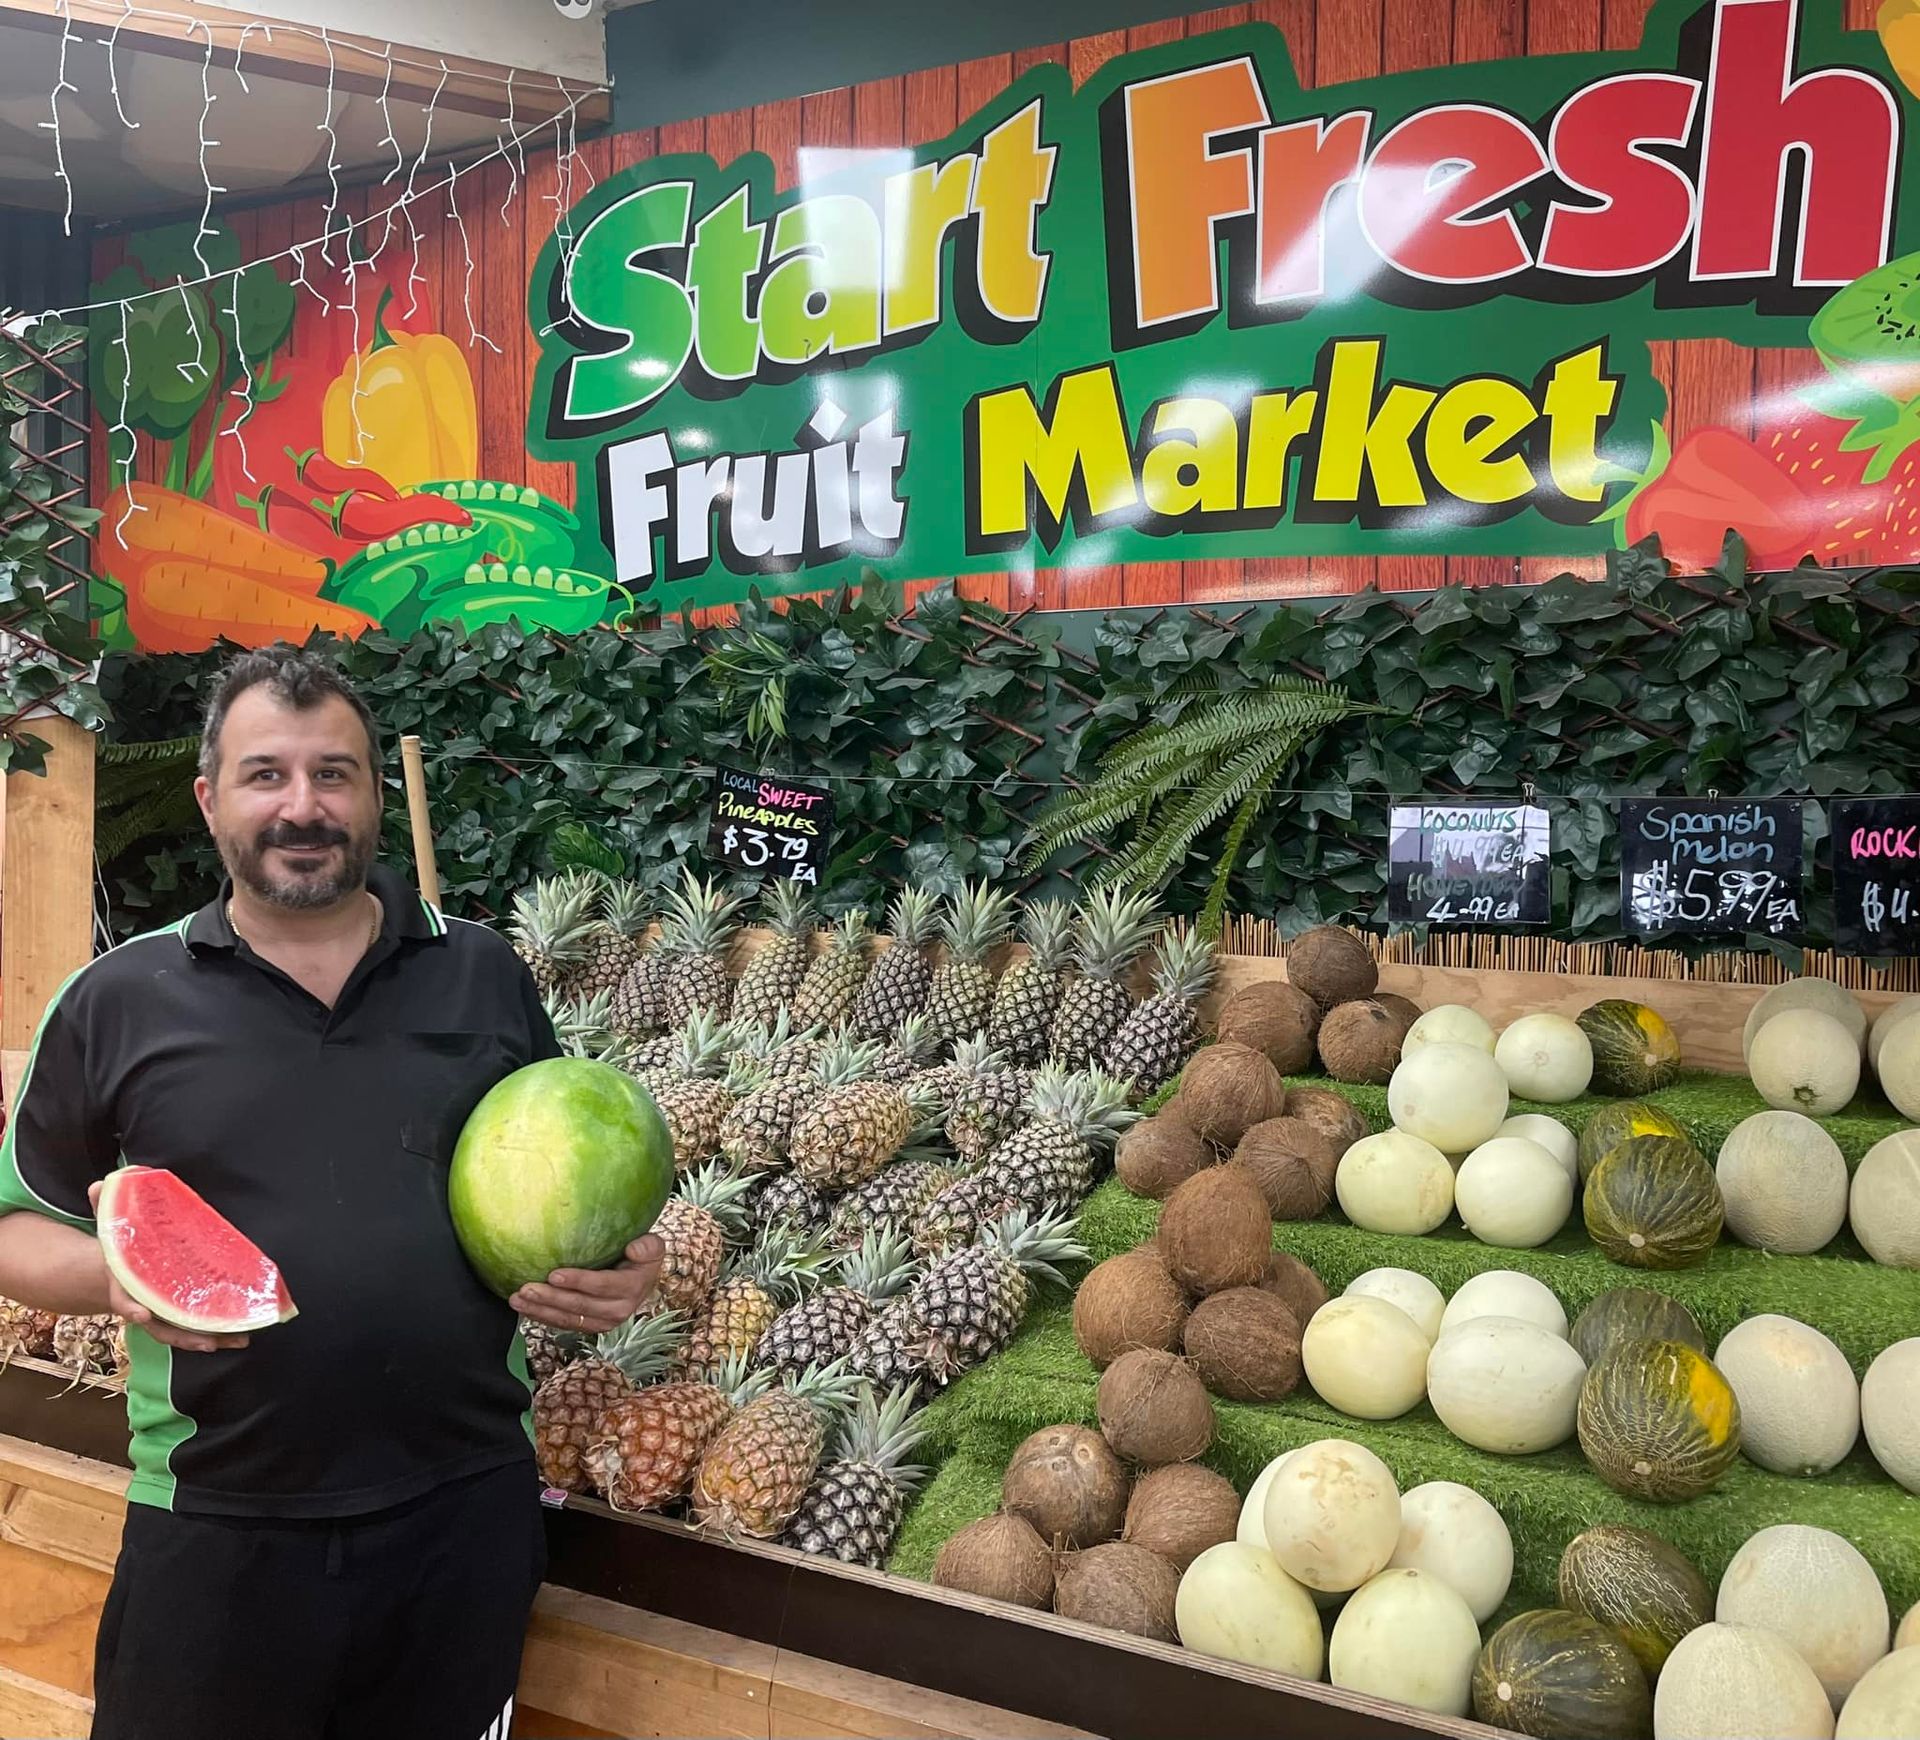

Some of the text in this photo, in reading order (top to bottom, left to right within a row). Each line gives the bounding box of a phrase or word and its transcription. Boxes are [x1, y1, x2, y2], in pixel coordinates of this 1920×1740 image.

[564, 0, 1900, 421] Start Fresh
[607, 340, 1617, 583] Fruit Market
[722, 770, 825, 811] LOCAL SWEET
[1420, 809, 1518, 833] COCONUTS
[1639, 805, 1776, 843] Spanish
[722, 825, 809, 867] $3.79
[790, 862, 818, 886] EA
